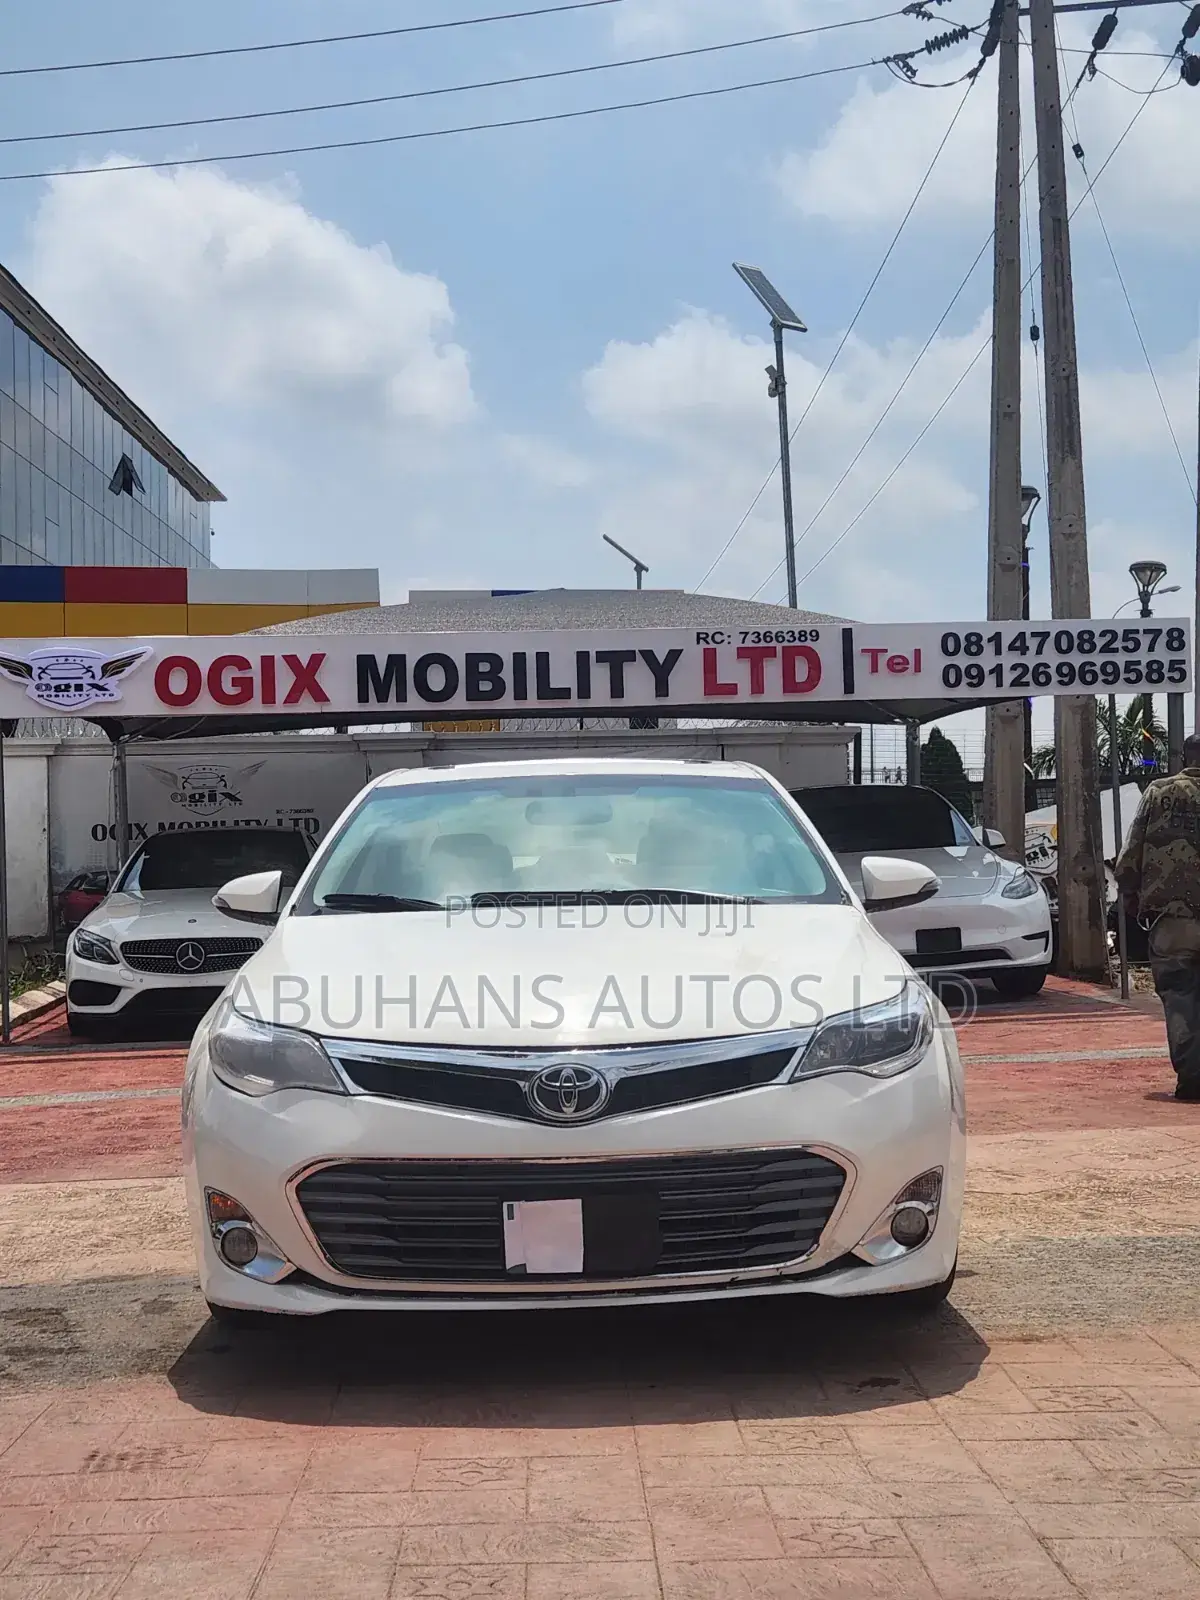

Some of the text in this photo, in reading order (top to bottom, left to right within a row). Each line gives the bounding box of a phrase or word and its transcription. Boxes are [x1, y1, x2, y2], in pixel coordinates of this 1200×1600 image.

[696, 629, 820, 645] RC: 7366389
[940, 627, 1186, 657] 08147082578
[154, 645, 922, 707] OGIX MOBILITY LTD Tel
[942, 659, 1188, 689] 09126969585
